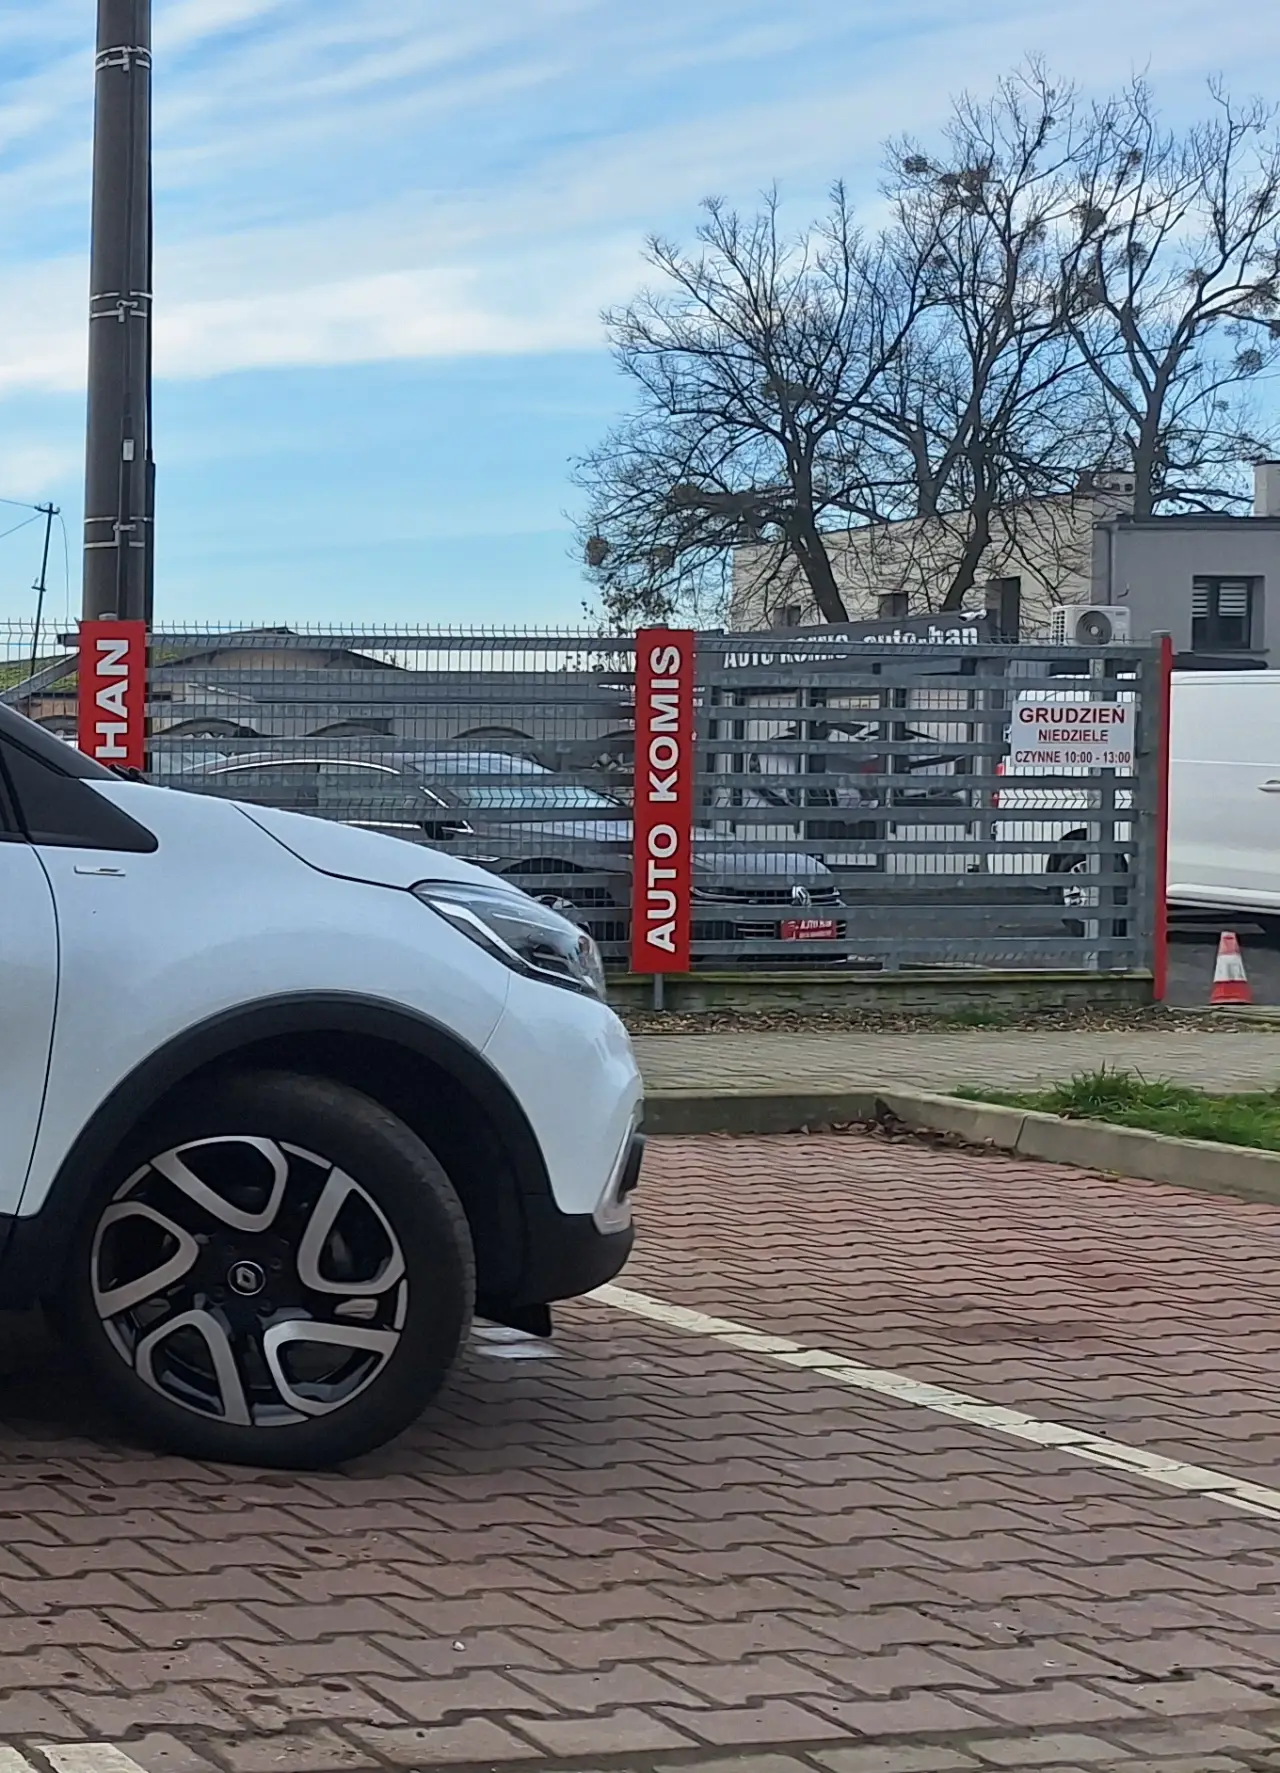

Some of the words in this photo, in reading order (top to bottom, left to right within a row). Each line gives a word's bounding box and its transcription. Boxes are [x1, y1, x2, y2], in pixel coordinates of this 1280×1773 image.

[649, 646, 681, 802] KOMIS
[1019, 704, 1125, 724] GRUDZIEŃ
[1038, 729, 1109, 742] NIEDZIELE
[1015, 750, 1061, 763] CZYNNE
[1065, 751, 1093, 763] 10:00
[1103, 751, 1131, 763] 13:00
[647, 823, 678, 953] AUTO
